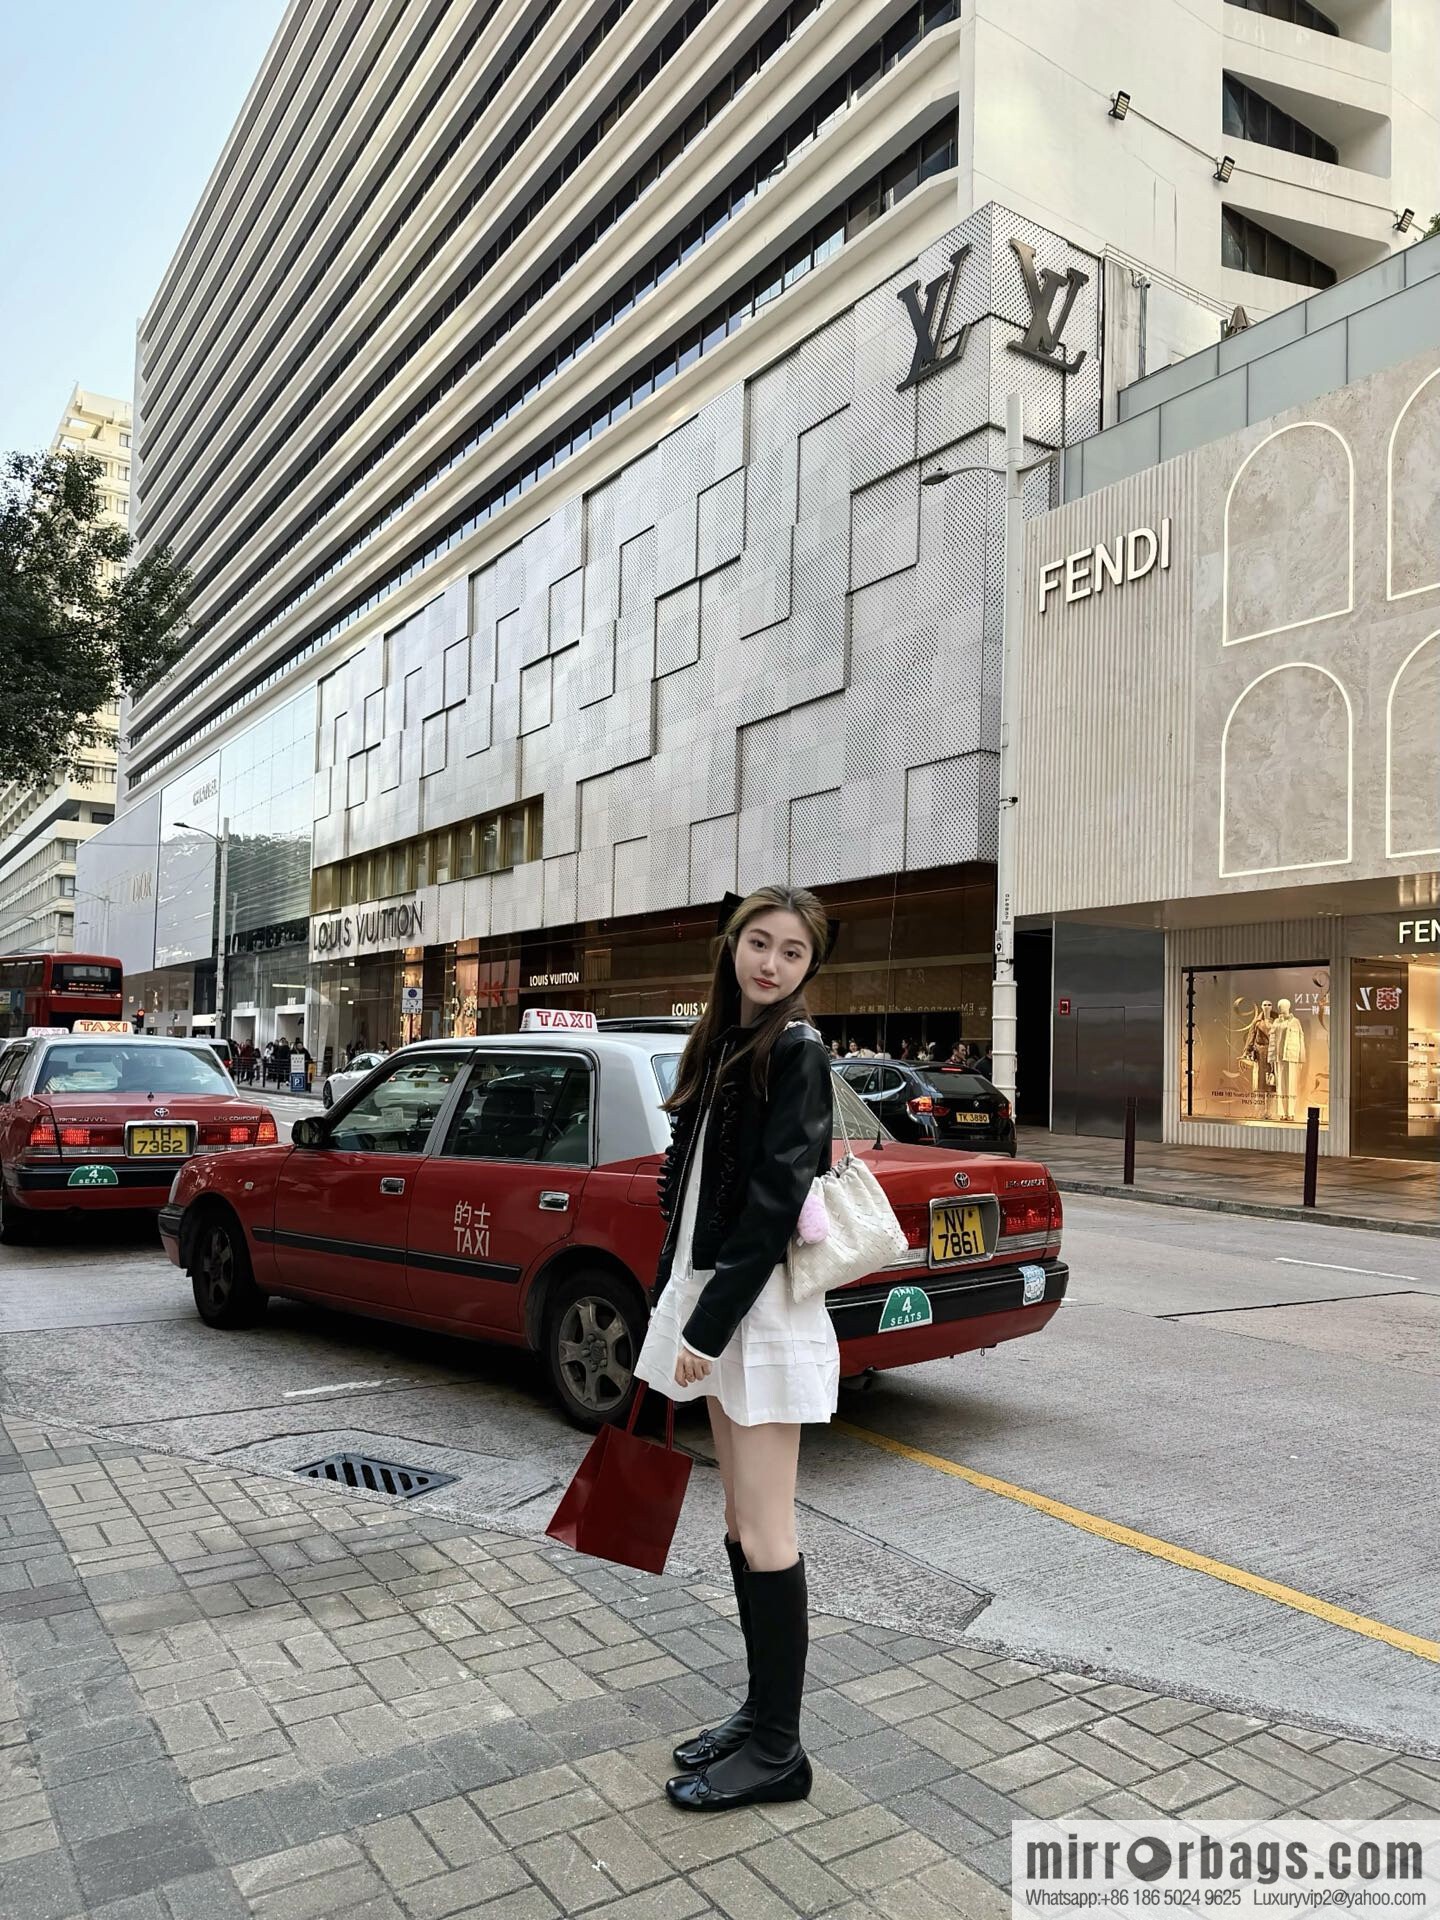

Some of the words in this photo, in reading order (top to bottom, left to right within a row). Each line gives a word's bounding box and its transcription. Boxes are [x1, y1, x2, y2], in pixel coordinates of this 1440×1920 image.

[1039, 517, 1171, 613] FENDI
[313, 916, 352, 951] LOUIS
[356, 900, 423, 944] VUITTON
[1399, 919, 1440, 944] FEN
[529, 974, 549, 987] LOUIS
[549, 972, 580, 986] VUITTON
[671, 1002, 698, 1016] LOUIS
[80, 1021, 128, 1032] TAXI
[536, 1011, 593, 1029] TAXI
[31, 1028, 67, 1036] TAXI
[958, 1114, 968, 1122] TK
[149, 1128, 171, 1141] TH
[137, 1140, 183, 1153] 7362
[88, 1169, 98, 1179] 4
[453, 1200, 491, 1229] 的士
[944, 1209, 965, 1233] NV
[453, 1226, 490, 1257] TAXI
[938, 1230, 979, 1258] 7861
[893, 1287, 915, 1298] TAXI
[902, 1296, 912, 1314] 4
[890, 1312, 922, 1327] SEATS
